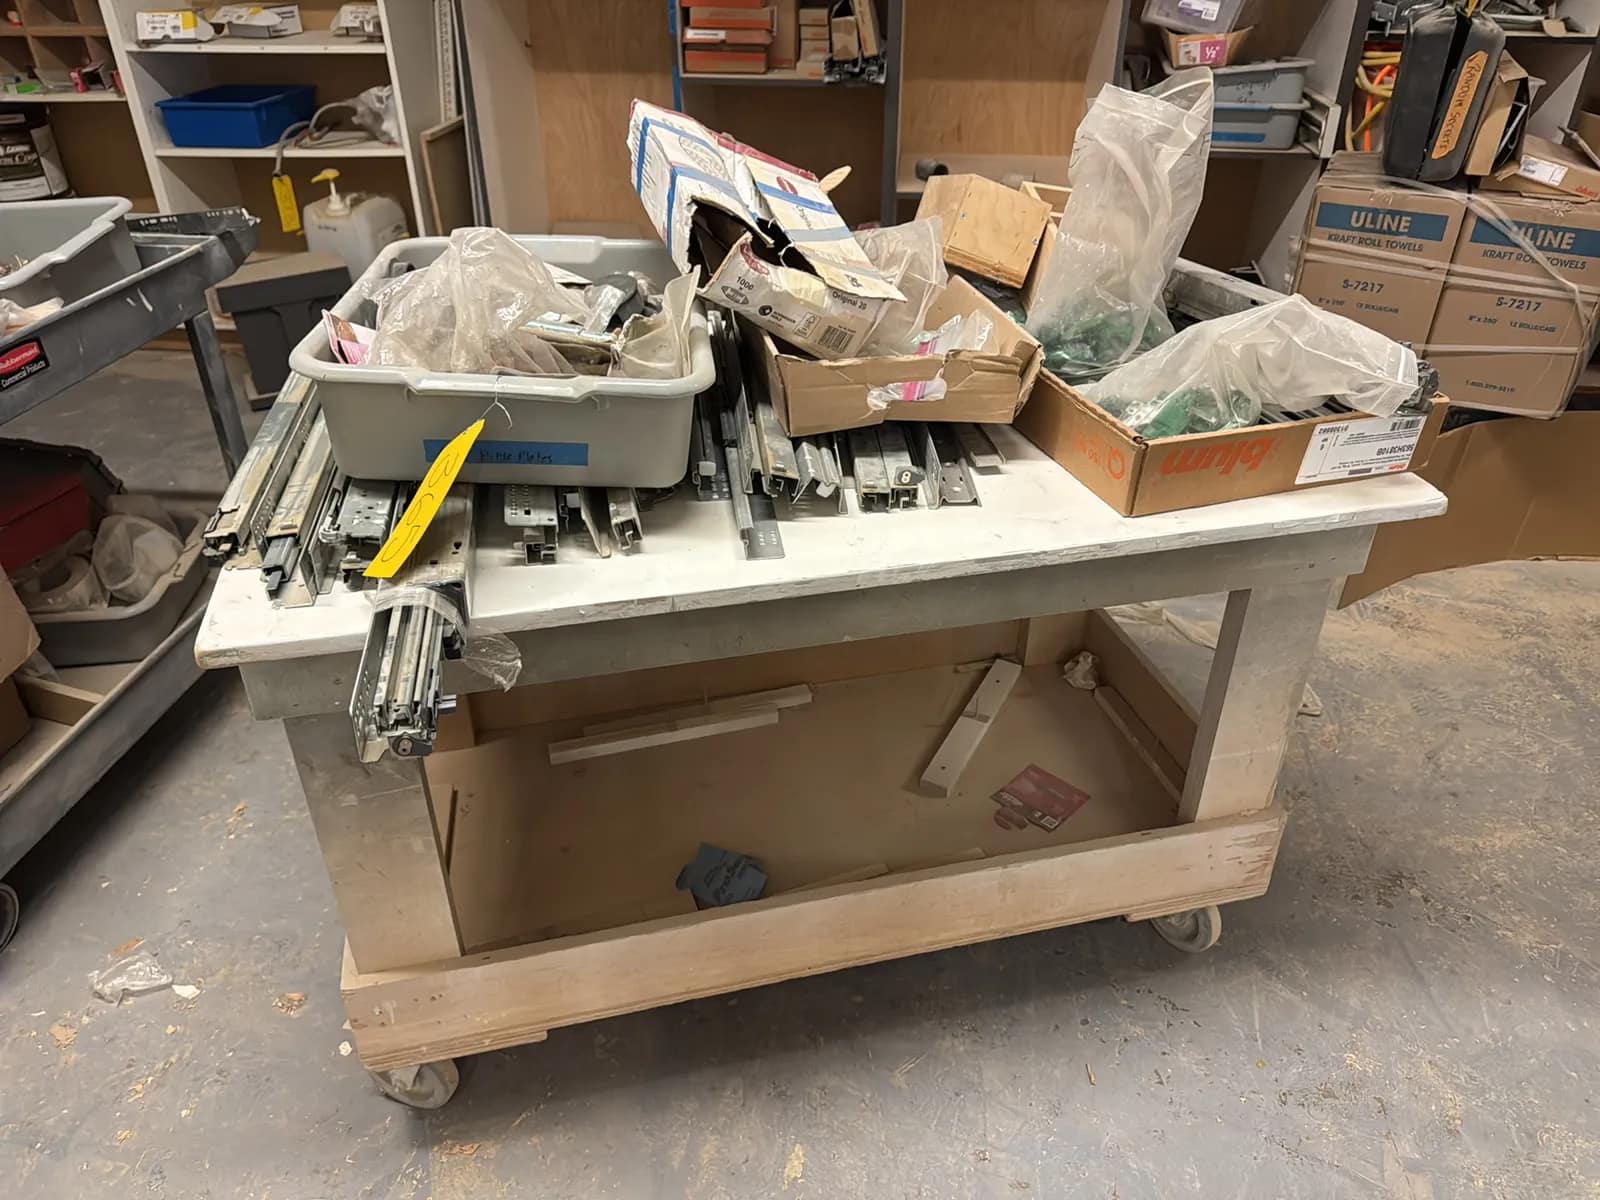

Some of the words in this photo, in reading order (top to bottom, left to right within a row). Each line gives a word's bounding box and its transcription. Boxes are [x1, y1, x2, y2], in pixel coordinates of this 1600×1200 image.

[1350, 210, 1412, 233] ULINE
[1327, 231, 1356, 244] KRAFT
[1357, 236, 1383, 248] ROLL
[1385, 239, 1424, 252] TOWELS
[1482, 248, 1515, 261] KRAFT
[1515, 253, 1541, 265] ROL
[1342, 279, 1385, 294] S-7217
[831, 290, 858, 307] Original
[1495, 296, 1542, 313] S-7217
[1161, 436, 1276, 476] blum
